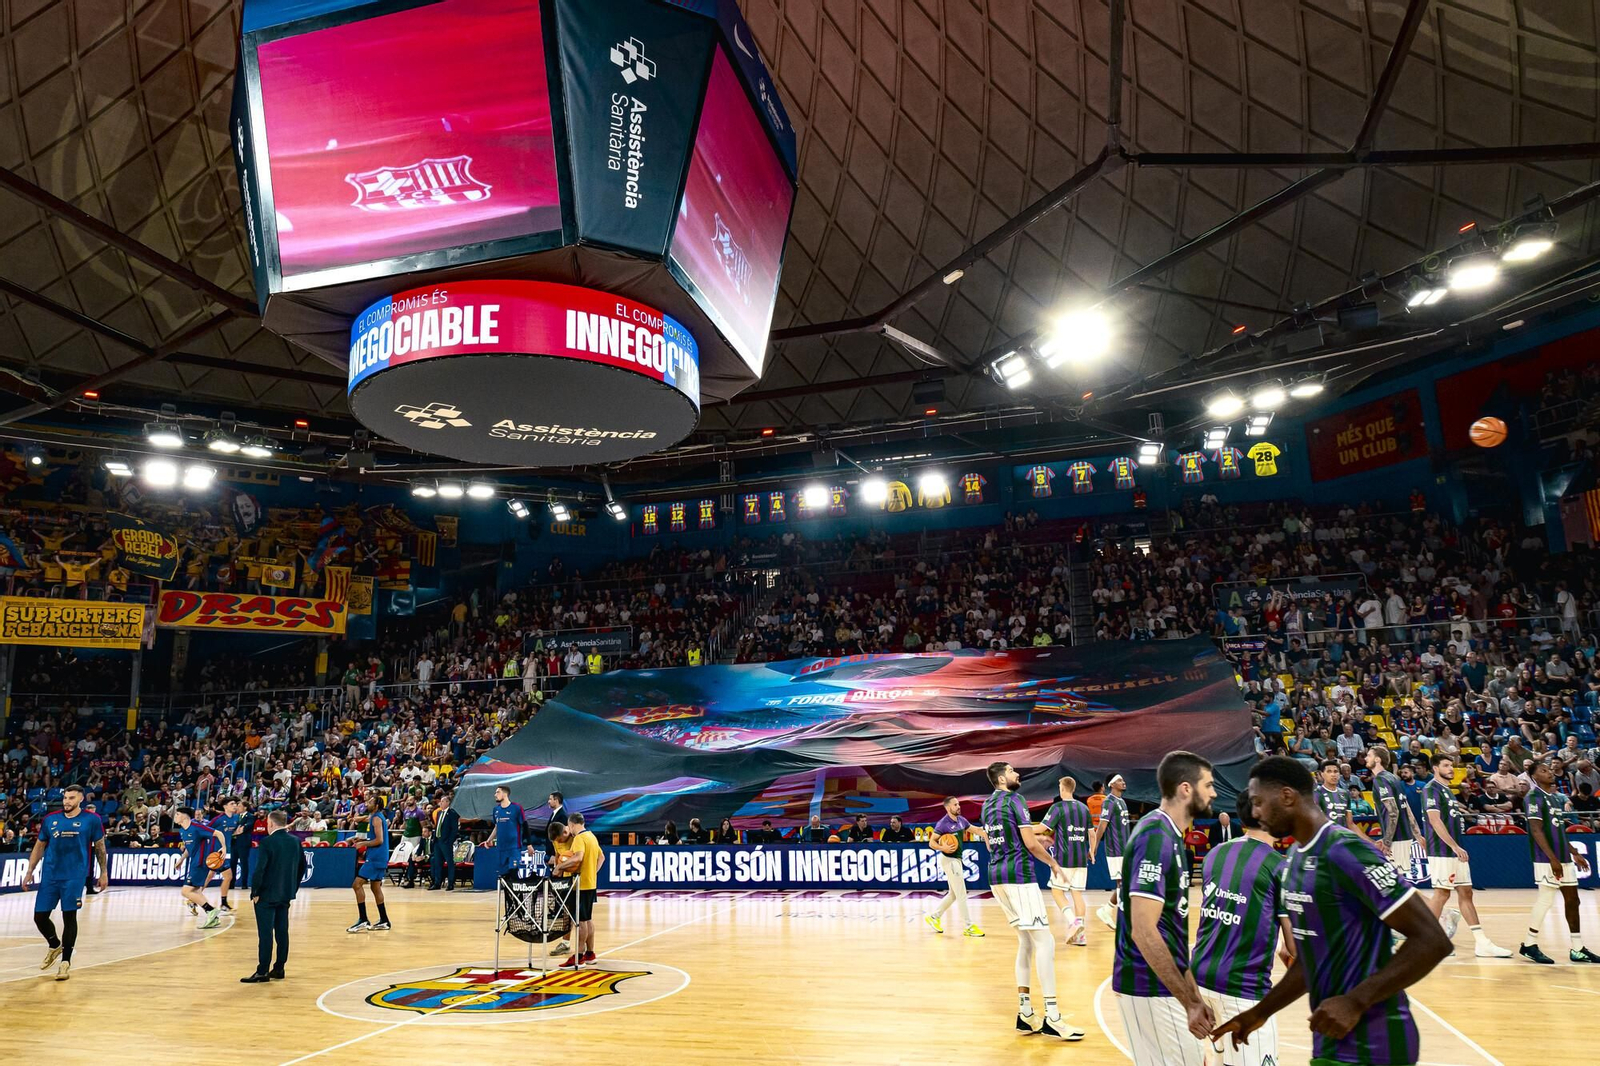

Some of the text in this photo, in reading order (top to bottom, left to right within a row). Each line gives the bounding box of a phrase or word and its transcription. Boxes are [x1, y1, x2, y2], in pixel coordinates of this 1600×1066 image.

[607, 92, 629, 171] Sanitària
[625, 96, 648, 209] Assistència
[358, 321, 366, 334] EL
[431, 289, 448, 306] ÉS
[615, 303, 630, 319] EL
[348, 304, 500, 387] NEGOCIABLE
[488, 428, 602, 446] Sanitària
[492, 418, 658, 440] Assistència
[1336, 416, 1395, 447] MÉS QUE
[1255, 450, 1273, 462] 28
[1339, 437, 1397, 466] UN CLUB
[1187, 458, 1196, 470] 4
[1223, 454, 1232, 466] 2
[1036, 473, 1045, 485] 8
[1077, 469, 1086, 480] 7
[1119, 465, 1128, 477] 5
[965, 480, 980, 492] 14
[747, 502, 755, 512] 7
[773, 499, 781, 510] 4
[832, 494, 841, 504] 9
[643, 512, 656, 523] 15
[671, 510, 684, 521] 12
[700, 507, 712, 518] 11
[121, 528, 164, 546] GRADA
[124, 540, 162, 559] REBEL
[4, 606, 142, 624] SUPPORTERS
[157, 591, 343, 629] DRACS
[195, 614, 306, 628] 1991
[3, 621, 141, 638] FCBARCELNA
[608, 845, 980, 883] LES ARRELS SÓN INNEGOCIABLS
[1215, 887, 1247, 904] Unicaja
